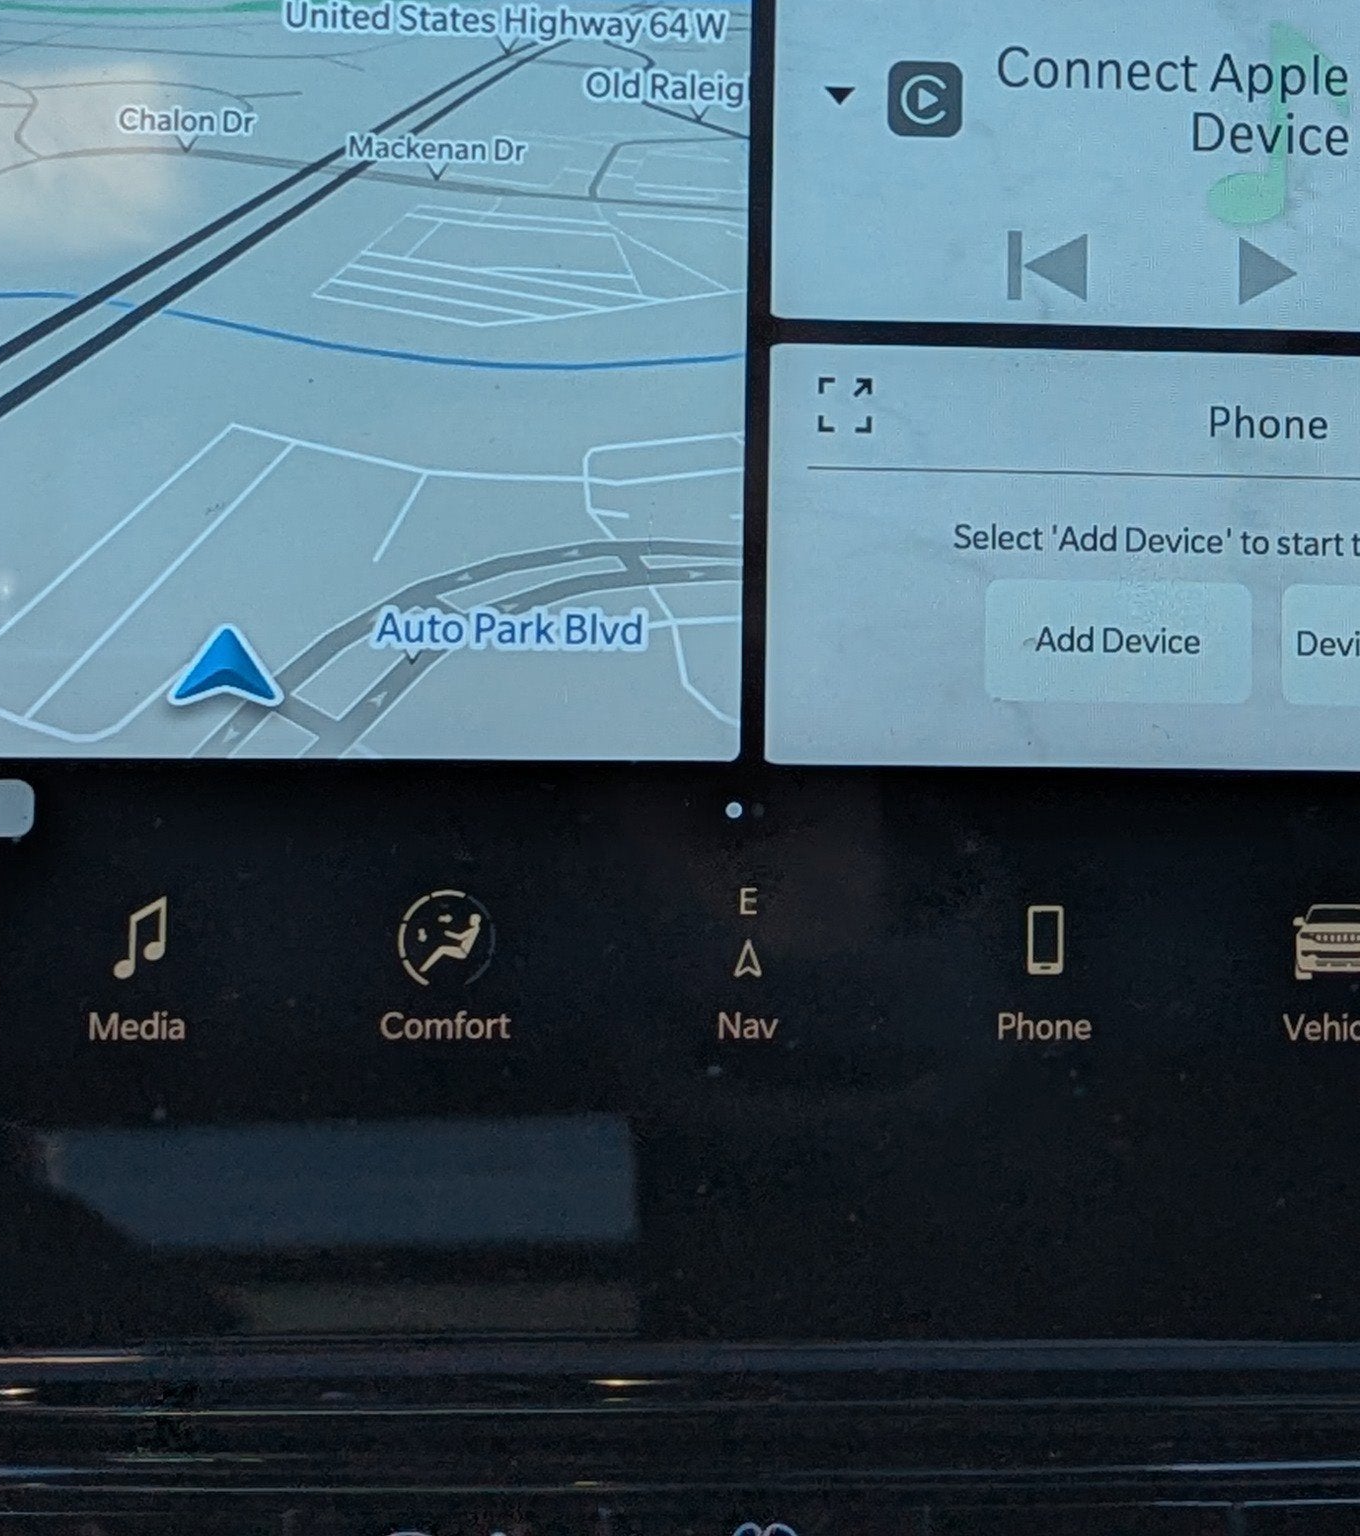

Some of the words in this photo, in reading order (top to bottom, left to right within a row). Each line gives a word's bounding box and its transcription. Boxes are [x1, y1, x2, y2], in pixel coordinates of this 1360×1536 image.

[286, 2, 390, 32] United
[400, 5, 496, 33] States
[506, 9, 642, 42] Highway
[649, 13, 694, 38] 64
[697, 14, 726, 39] W
[586, 72, 642, 100] Old
[651, 74, 749, 108] Raleig
[998, 46, 1199, 92] Connect
[1210, 53, 1349, 102] Apple
[119, 108, 214, 133] Chalon
[224, 110, 254, 134] Dr
[1192, 111, 1350, 157] Device
[349, 135, 489, 162] Mackenan
[495, 139, 525, 163] Dr
[1209, 405, 1329, 442] Phone
[953, 524, 1043, 555] Select
[1240, 531, 1269, 557] to
[1276, 531, 1344, 558] start
[376, 611, 466, 645] Auto
[473, 613, 554, 645] Park
[565, 614, 642, 647] Blvd
[1035, 625, 1095, 654] Add
[1102, 627, 1201, 656] Device
[88, 1011, 186, 1042] Media
[380, 1011, 512, 1041] Comfort
[718, 1012, 779, 1041] Nav
[997, 1012, 1093, 1042] Phone
